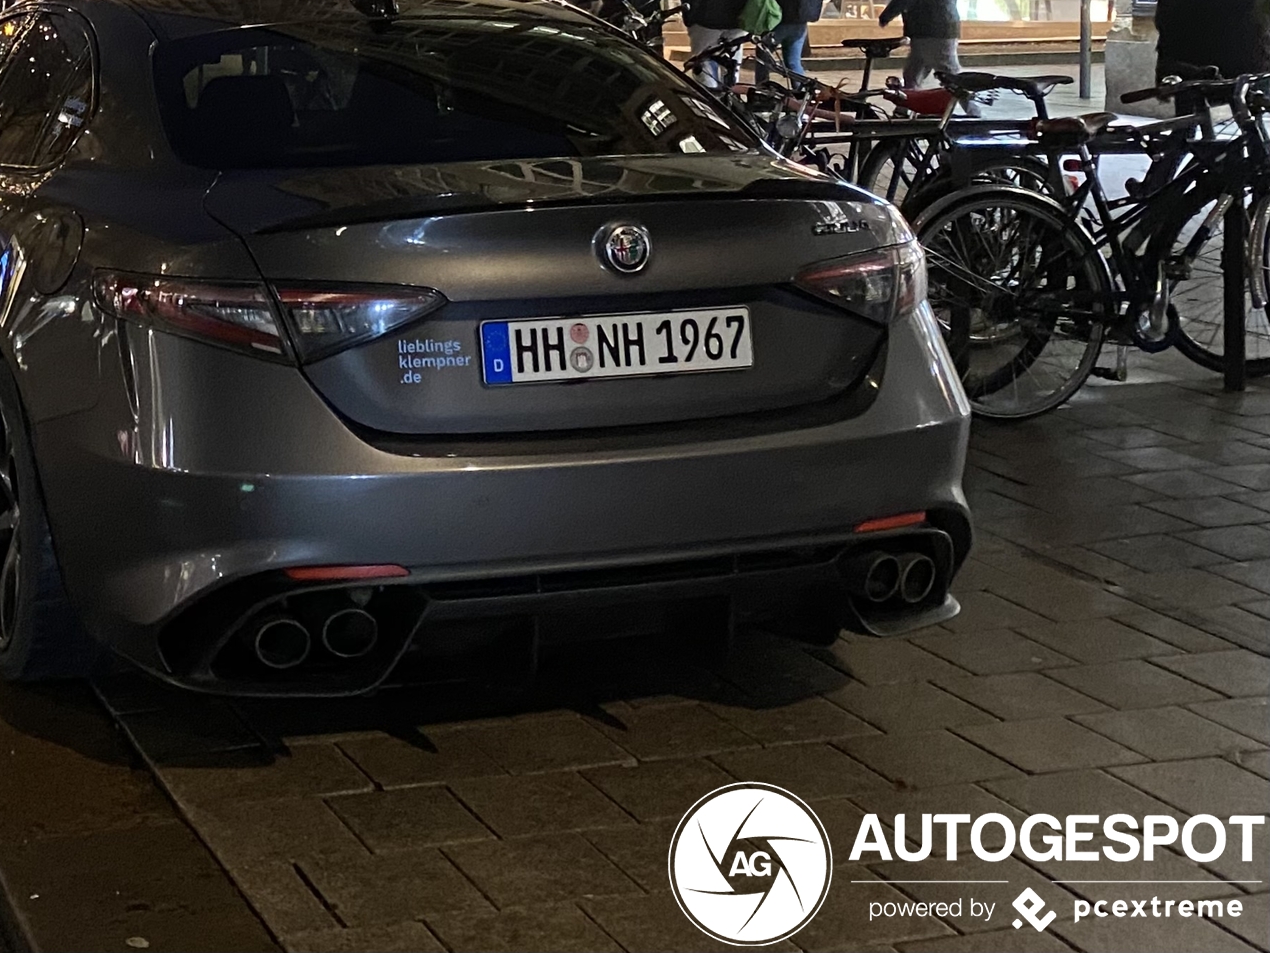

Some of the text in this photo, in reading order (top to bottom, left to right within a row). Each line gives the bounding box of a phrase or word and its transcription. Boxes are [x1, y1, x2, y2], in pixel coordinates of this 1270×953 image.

[398, 339, 461, 355] lieblings
[514, 315, 745, 374] HH NH 1967
[398, 354, 471, 371] klempner
[493, 358, 505, 373] D
[400, 370, 422, 384] .de
